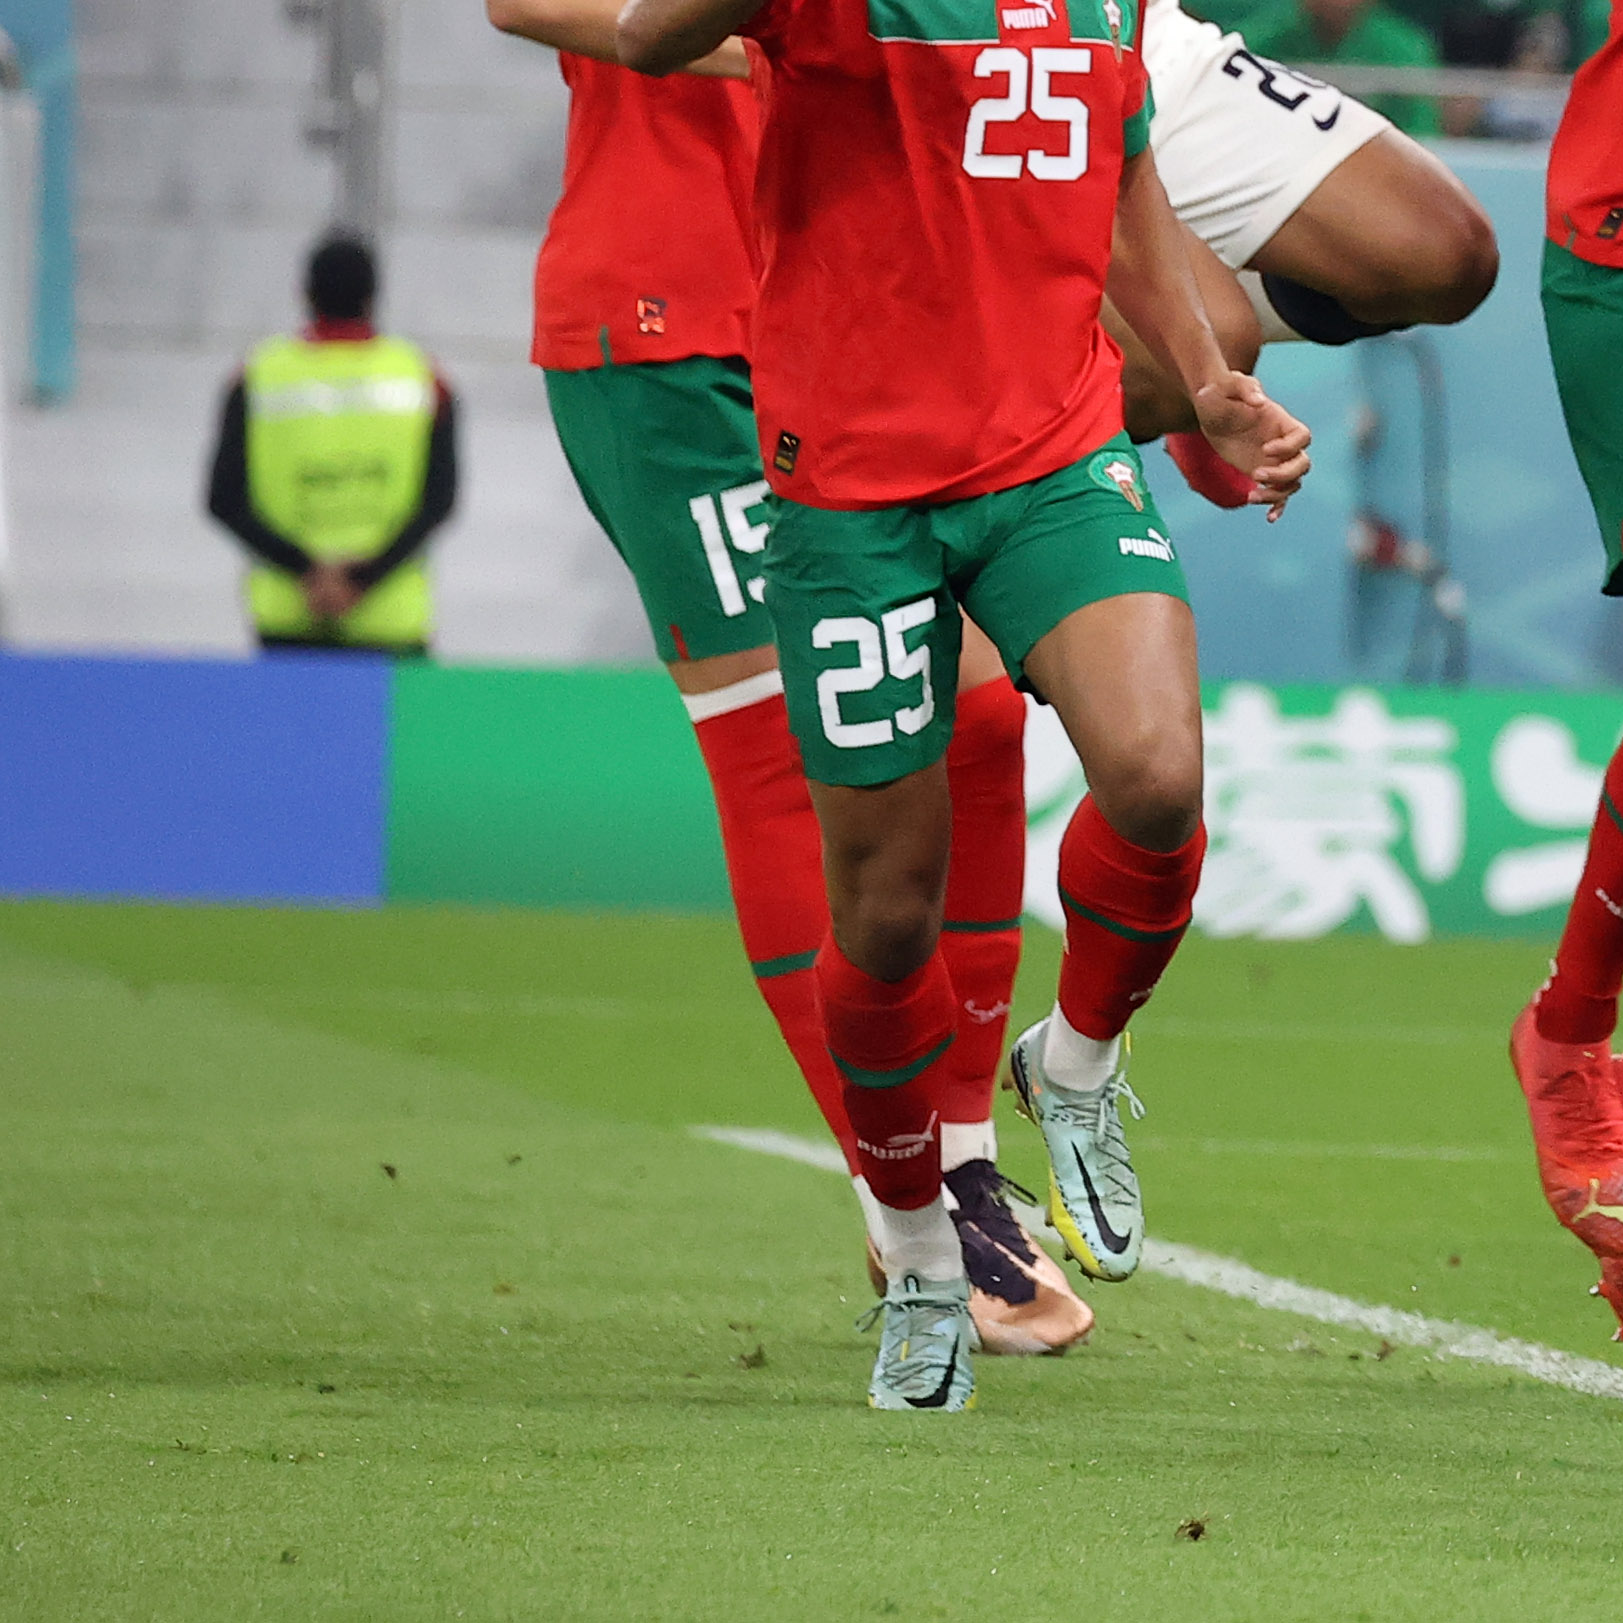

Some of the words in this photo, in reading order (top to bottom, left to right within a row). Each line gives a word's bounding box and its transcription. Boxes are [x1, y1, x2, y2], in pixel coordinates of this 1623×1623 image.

[961, 46, 1092, 182] 25
[1222, 48, 1316, 111] 2
[689, 479, 771, 617] 15
[1119, 537, 1171, 562] PUMA
[811, 596, 936, 748] 25
